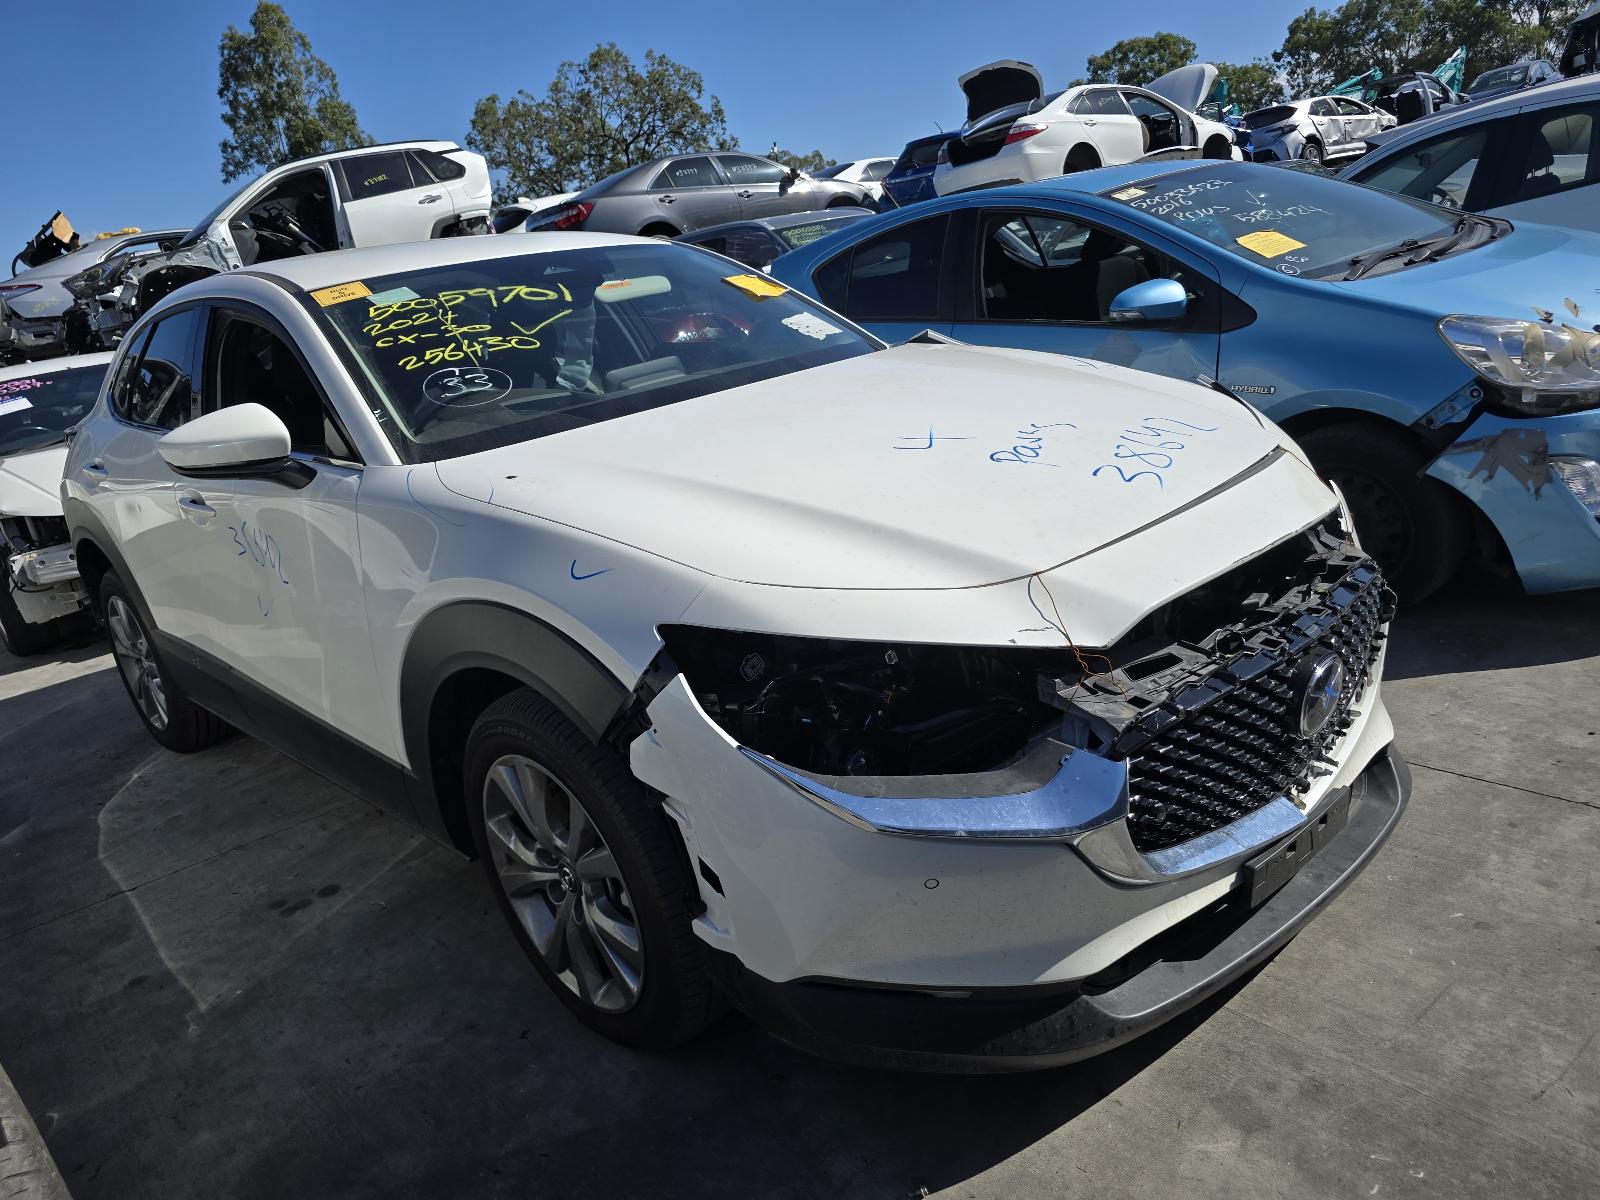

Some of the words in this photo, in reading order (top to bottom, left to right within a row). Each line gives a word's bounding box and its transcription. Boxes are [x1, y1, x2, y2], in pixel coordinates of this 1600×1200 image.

[1151, 198, 1193, 215] 2016
[331, 292, 357, 301] DRIVE
[363, 309, 459, 336] 2024
[398, 336, 541, 371] 256430
[1231, 384, 1270, 394] HYBRID
